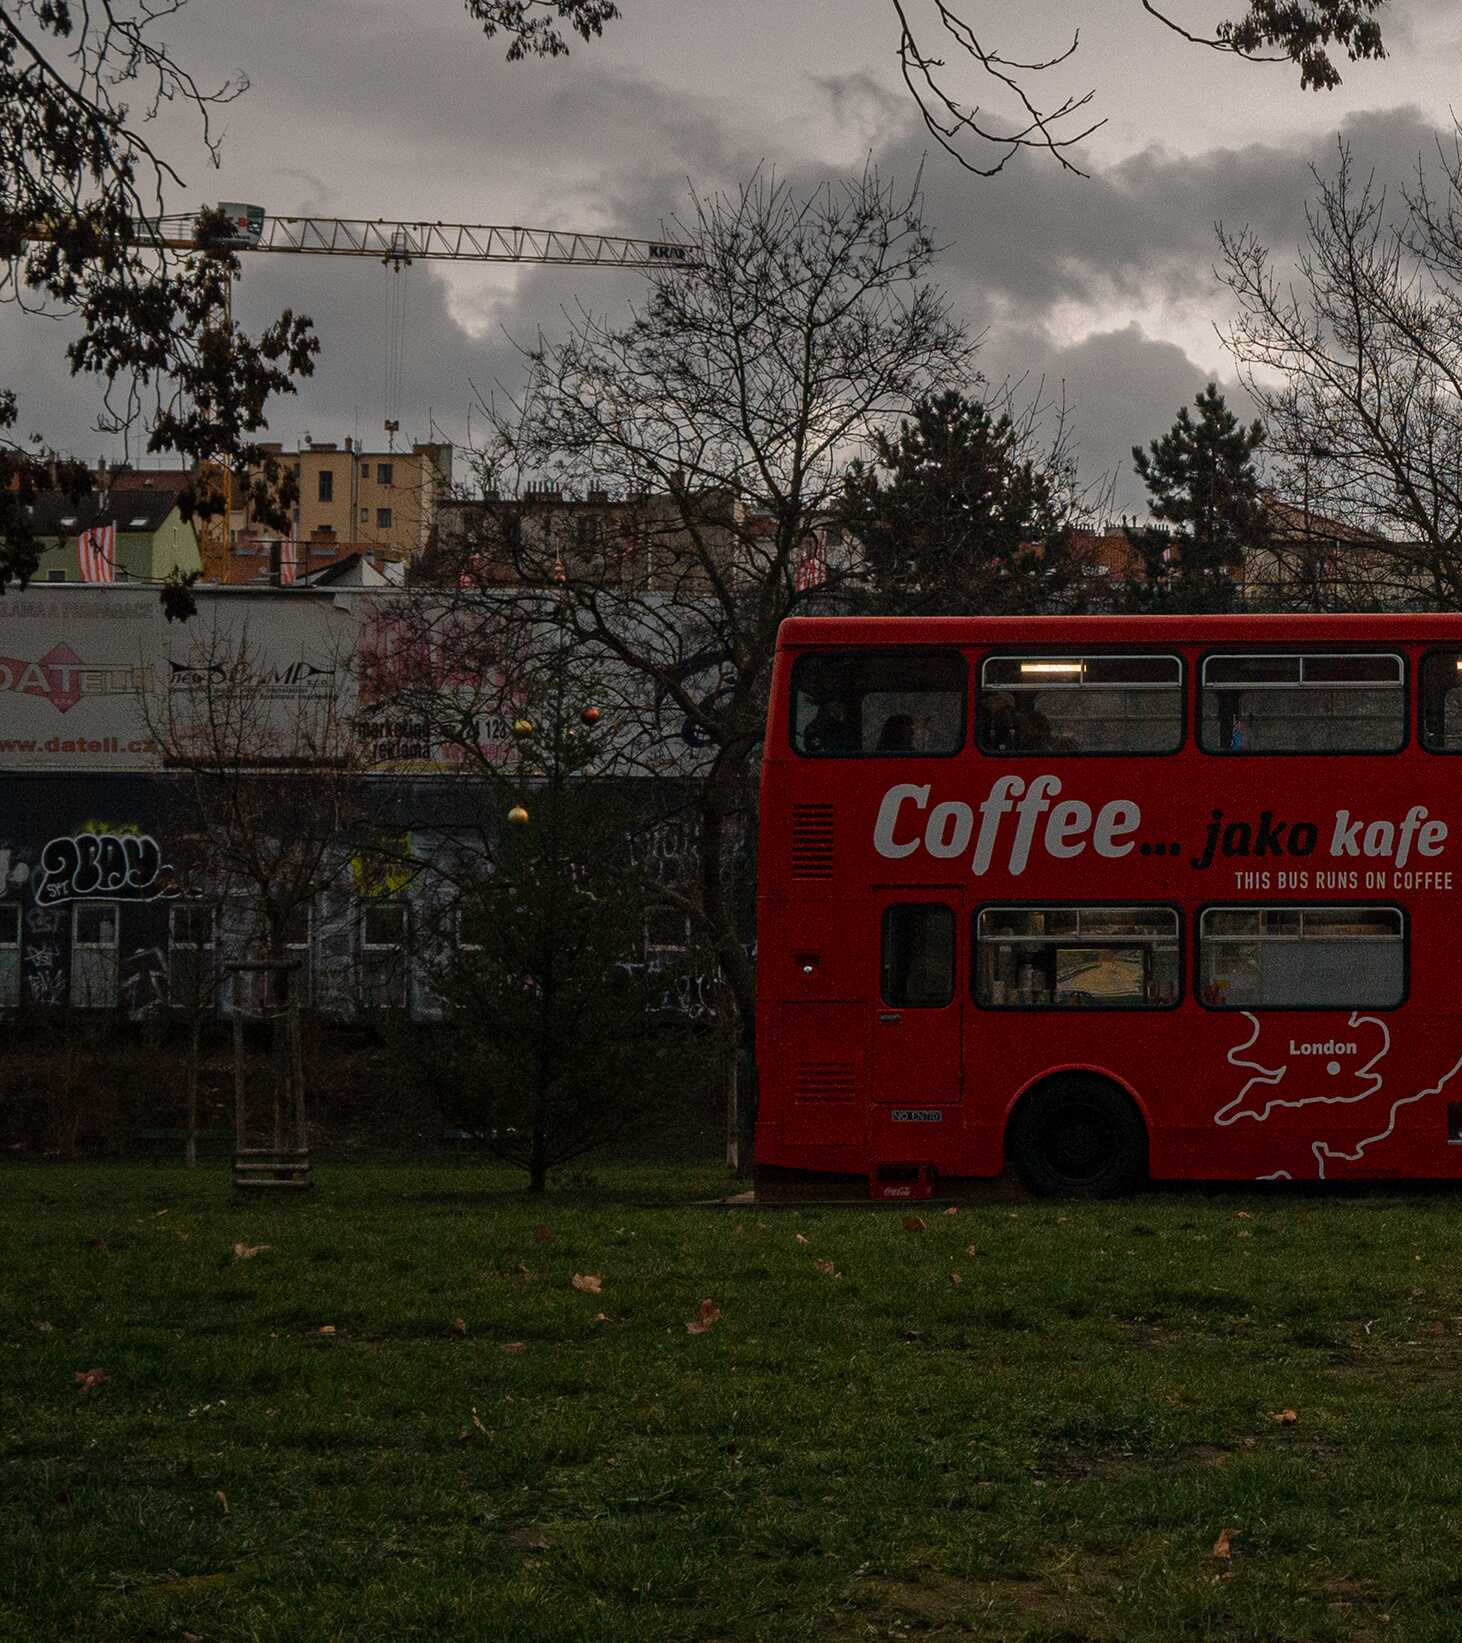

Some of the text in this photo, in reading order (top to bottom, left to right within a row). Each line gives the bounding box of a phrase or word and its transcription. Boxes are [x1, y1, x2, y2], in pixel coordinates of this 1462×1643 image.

[1191, 810, 1318, 868] jako
[1329, 805, 1449, 869] kafe
[1235, 871, 1453, 889] THIS BUS RUNS ON COFFEE
[1289, 1039, 1358, 1056] London
